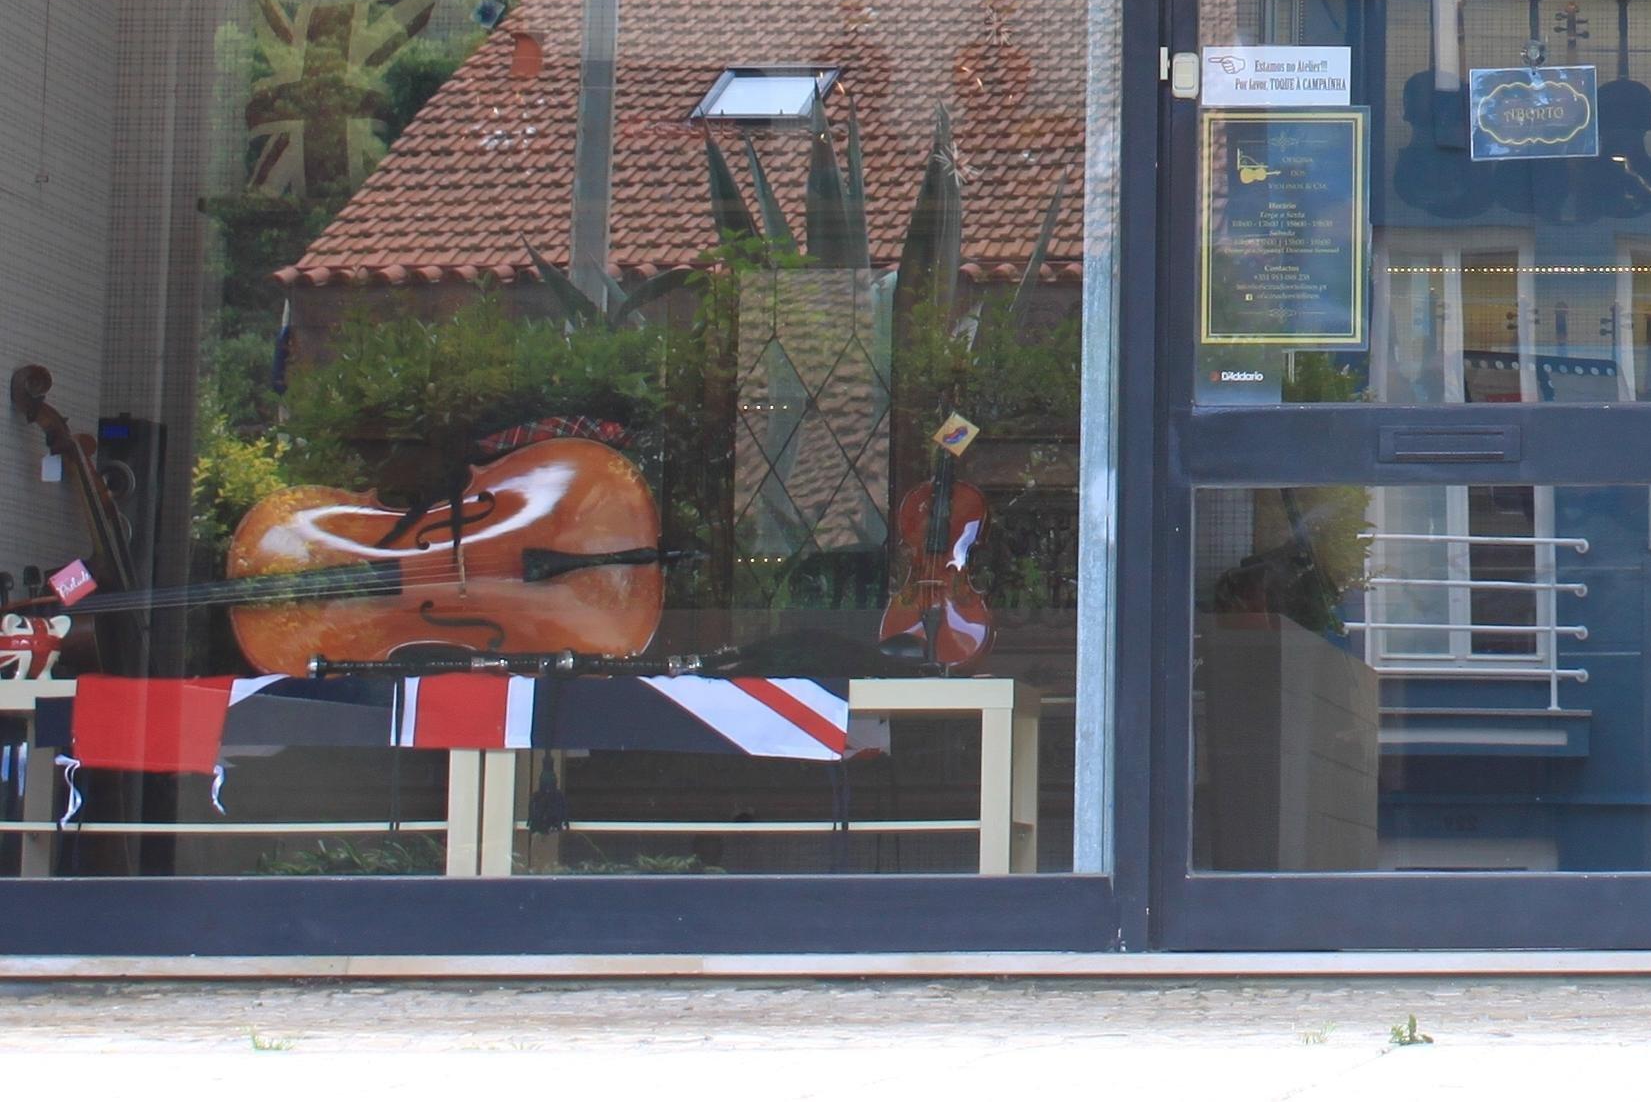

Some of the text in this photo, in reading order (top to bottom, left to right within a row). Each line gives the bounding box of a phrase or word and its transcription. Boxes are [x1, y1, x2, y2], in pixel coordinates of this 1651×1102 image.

[1255, 60, 1285, 72] Estamos
[1286, 63, 1296, 72] no
[1235, 78, 1248, 90] Por
[1270, 78, 1294, 90] TOQUE
[1221, 371, 1264, 382] D'Addario
